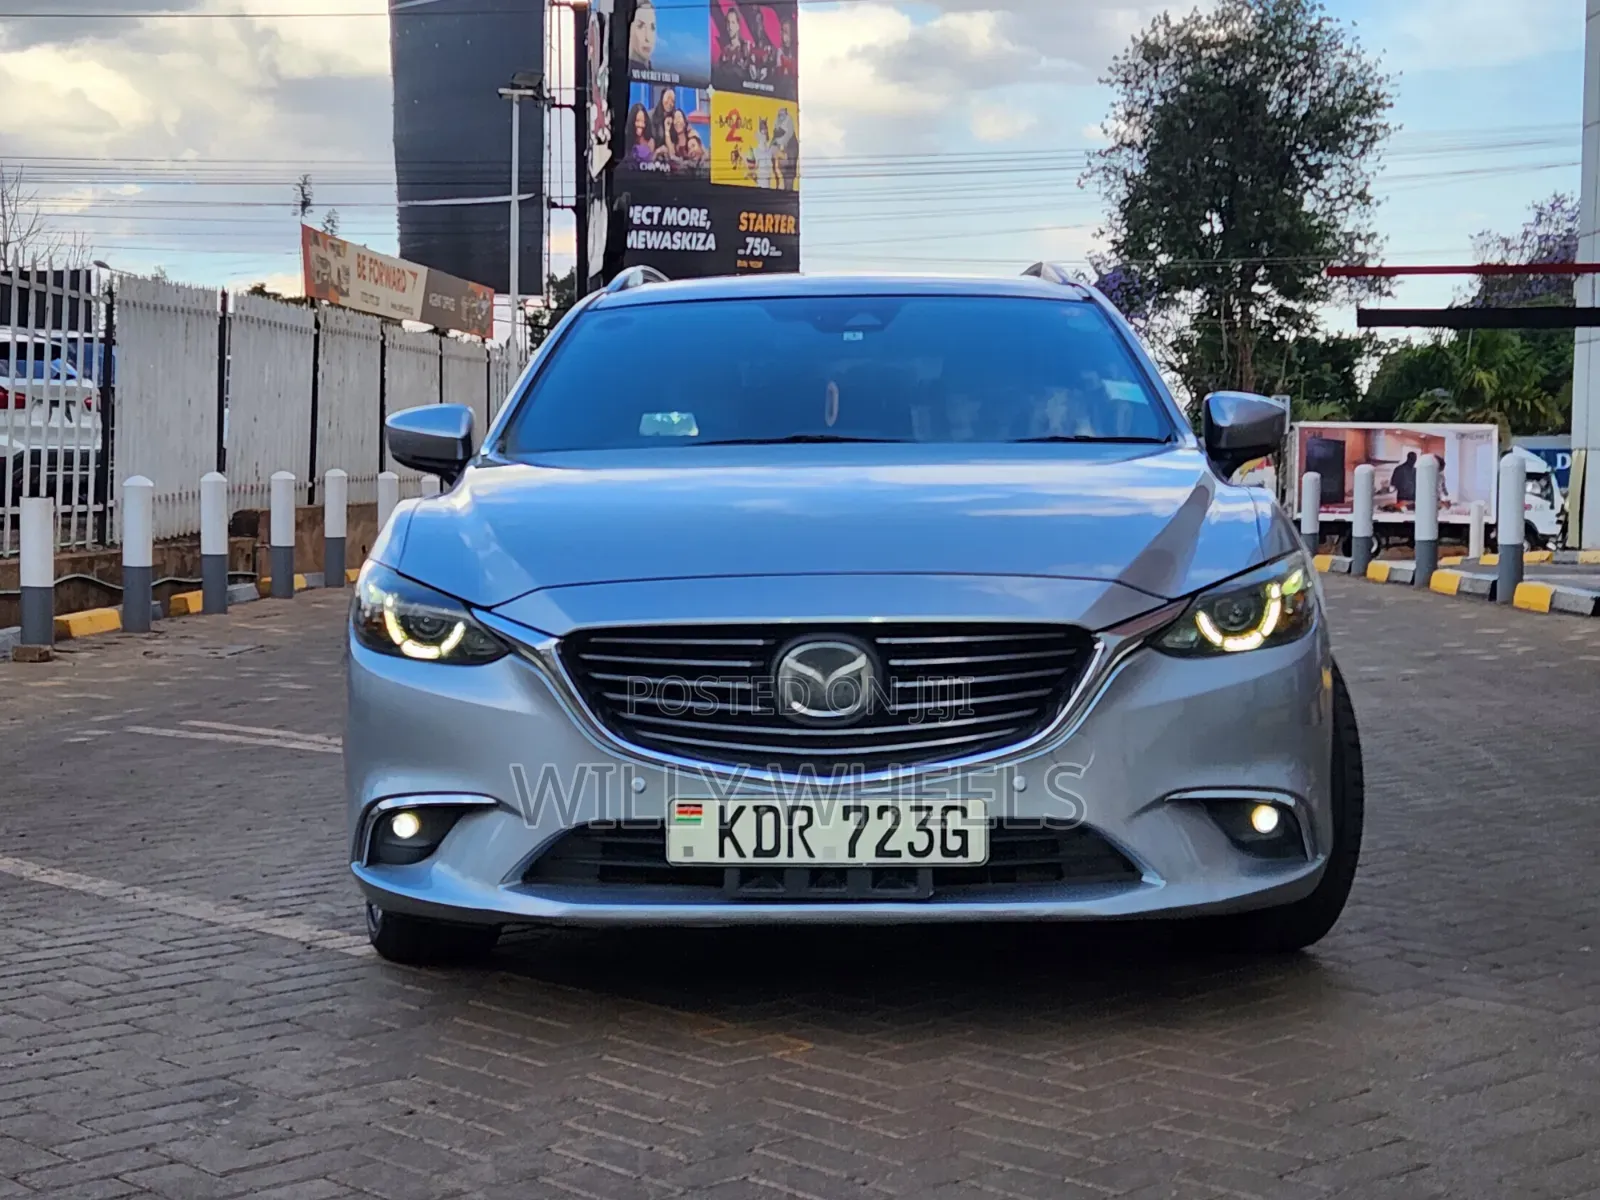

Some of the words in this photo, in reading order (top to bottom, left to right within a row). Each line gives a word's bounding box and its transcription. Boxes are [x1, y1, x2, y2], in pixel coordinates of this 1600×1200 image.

[629, 205, 661, 226] ECT
[662, 207, 711, 230] MORE,
[739, 212, 796, 234] STARTER
[745, 237, 770, 256] 750
[357, 252, 367, 281] BE
[368, 257, 407, 293] FORWARD
[717, 804, 814, 858] KDR
[842, 804, 970, 858] 723G
